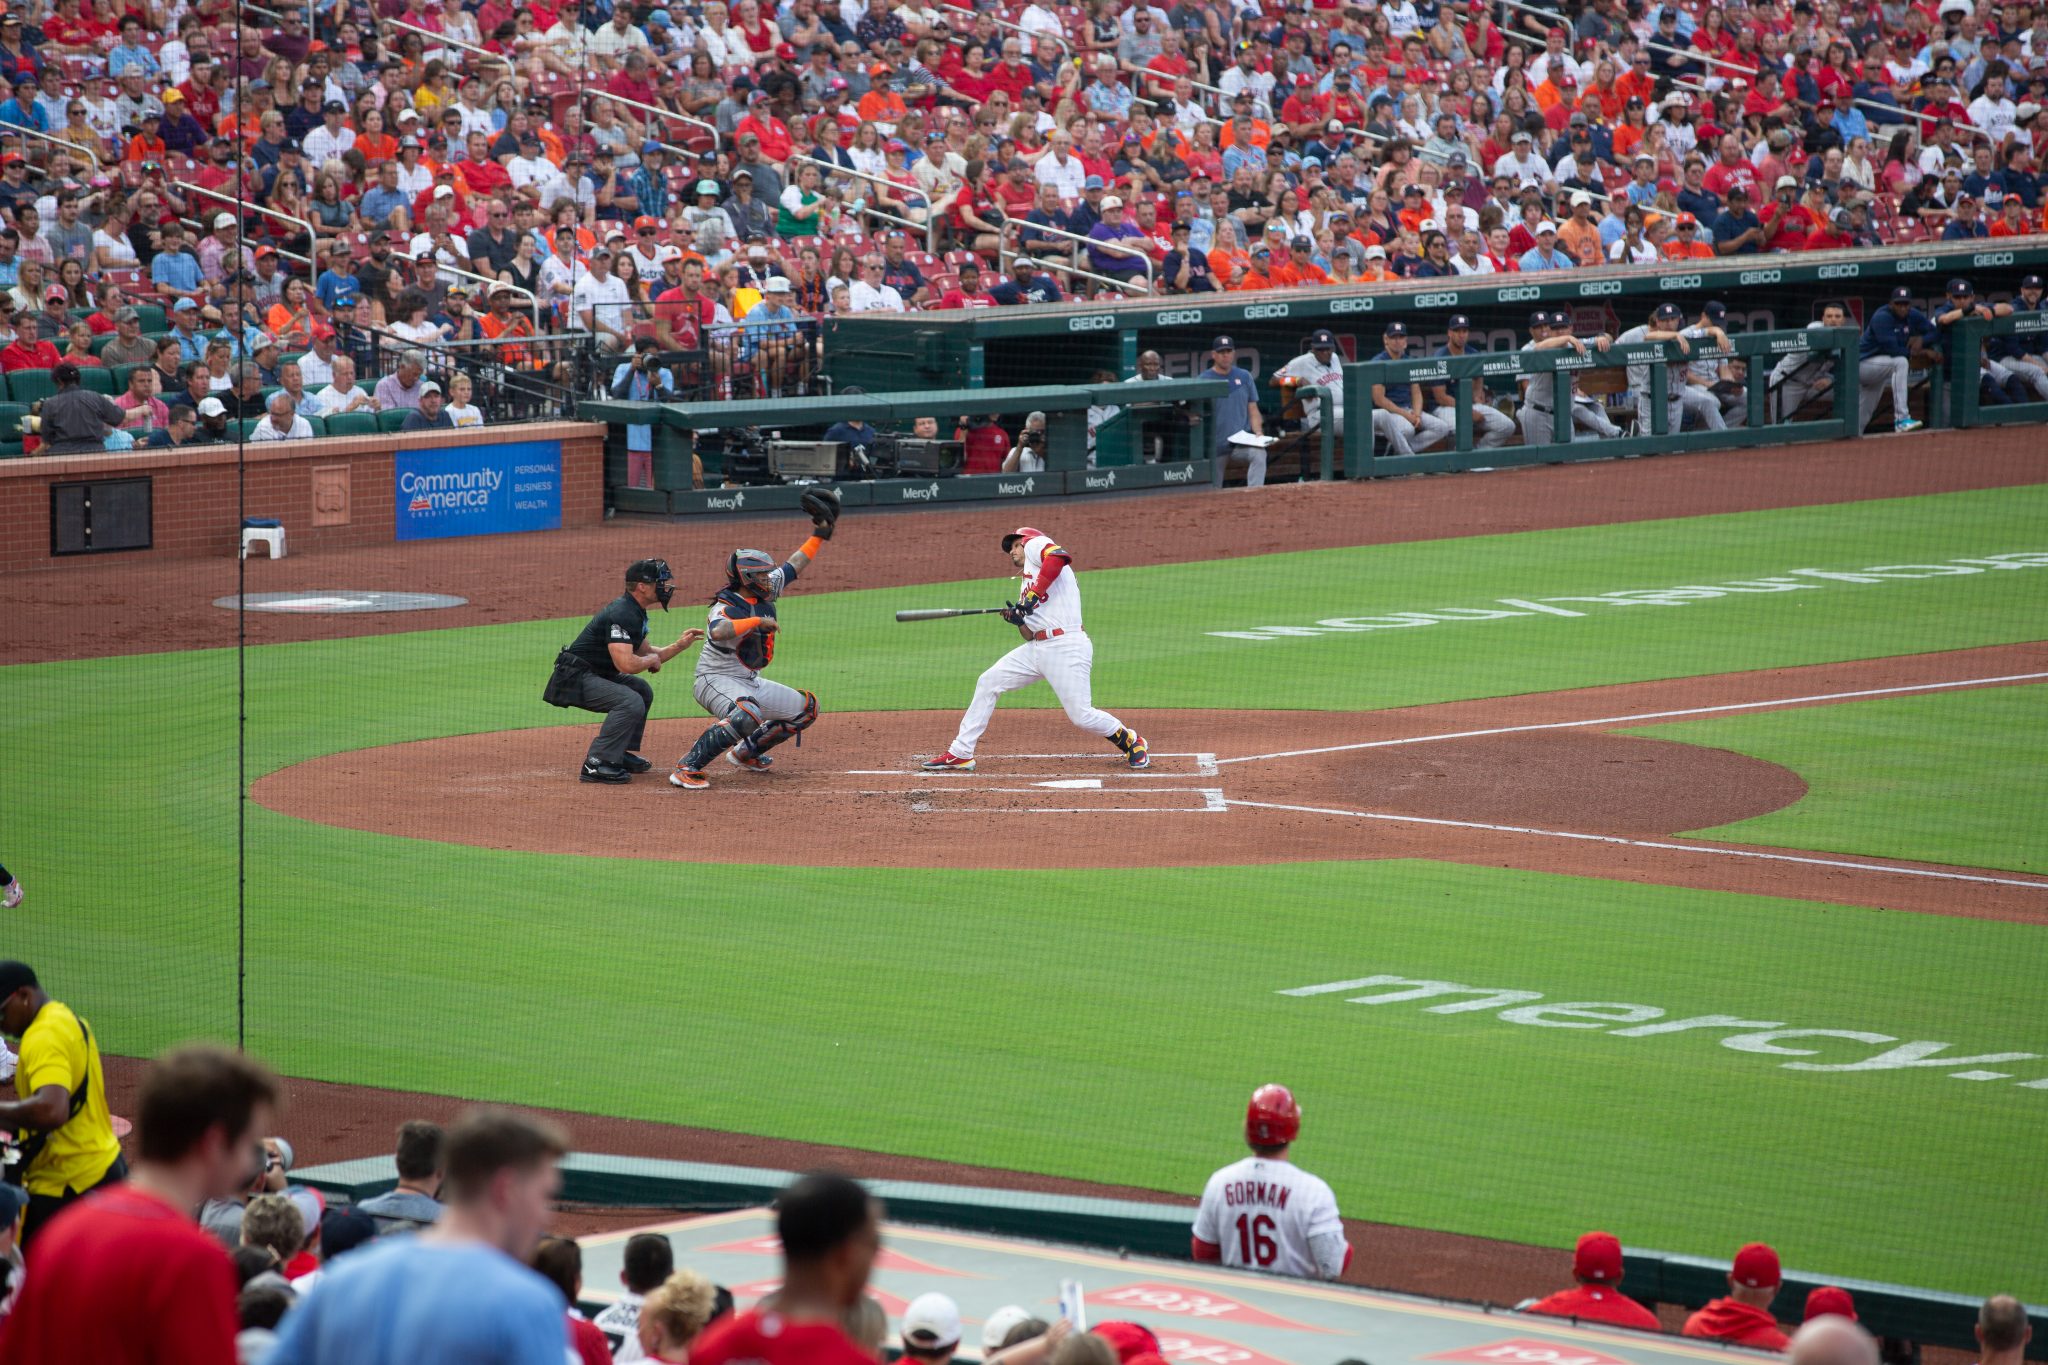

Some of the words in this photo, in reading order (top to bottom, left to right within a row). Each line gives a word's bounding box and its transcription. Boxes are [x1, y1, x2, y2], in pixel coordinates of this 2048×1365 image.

[1896, 258, 1937, 273] GEICO
[1974, 252, 2014, 267] GEICO
[1740, 270, 1781, 285] GEICO
[1818, 264, 1859, 279] GEICO
[1580, 281, 1622, 296] GEICO
[1660, 275, 1701, 290] GEICO
[1415, 293, 1458, 308] GEICO
[1498, 286, 1540, 301] GEICO
[1244, 304, 1289, 319] GEICO
[1330, 298, 1374, 313] GEICO
[1069, 315, 1115, 331] GEICO
[1156, 310, 1202, 325] GEICO
[514, 464, 556, 475] PERSONAL
[1163, 467, 1189, 482] Mercy
[400, 467, 504, 494] Community
[514, 482, 553, 492] BUSINESS
[1086, 475, 1111, 489] Mercy
[902, 487, 932, 501] Mercy
[998, 482, 1027, 495] Mercy
[514, 500, 548, 510] WEALTH
[707, 496, 738, 511] Mercy
[1224, 1181, 1292, 1210] GORMAN
[1236, 1213, 1277, 1267] 16
